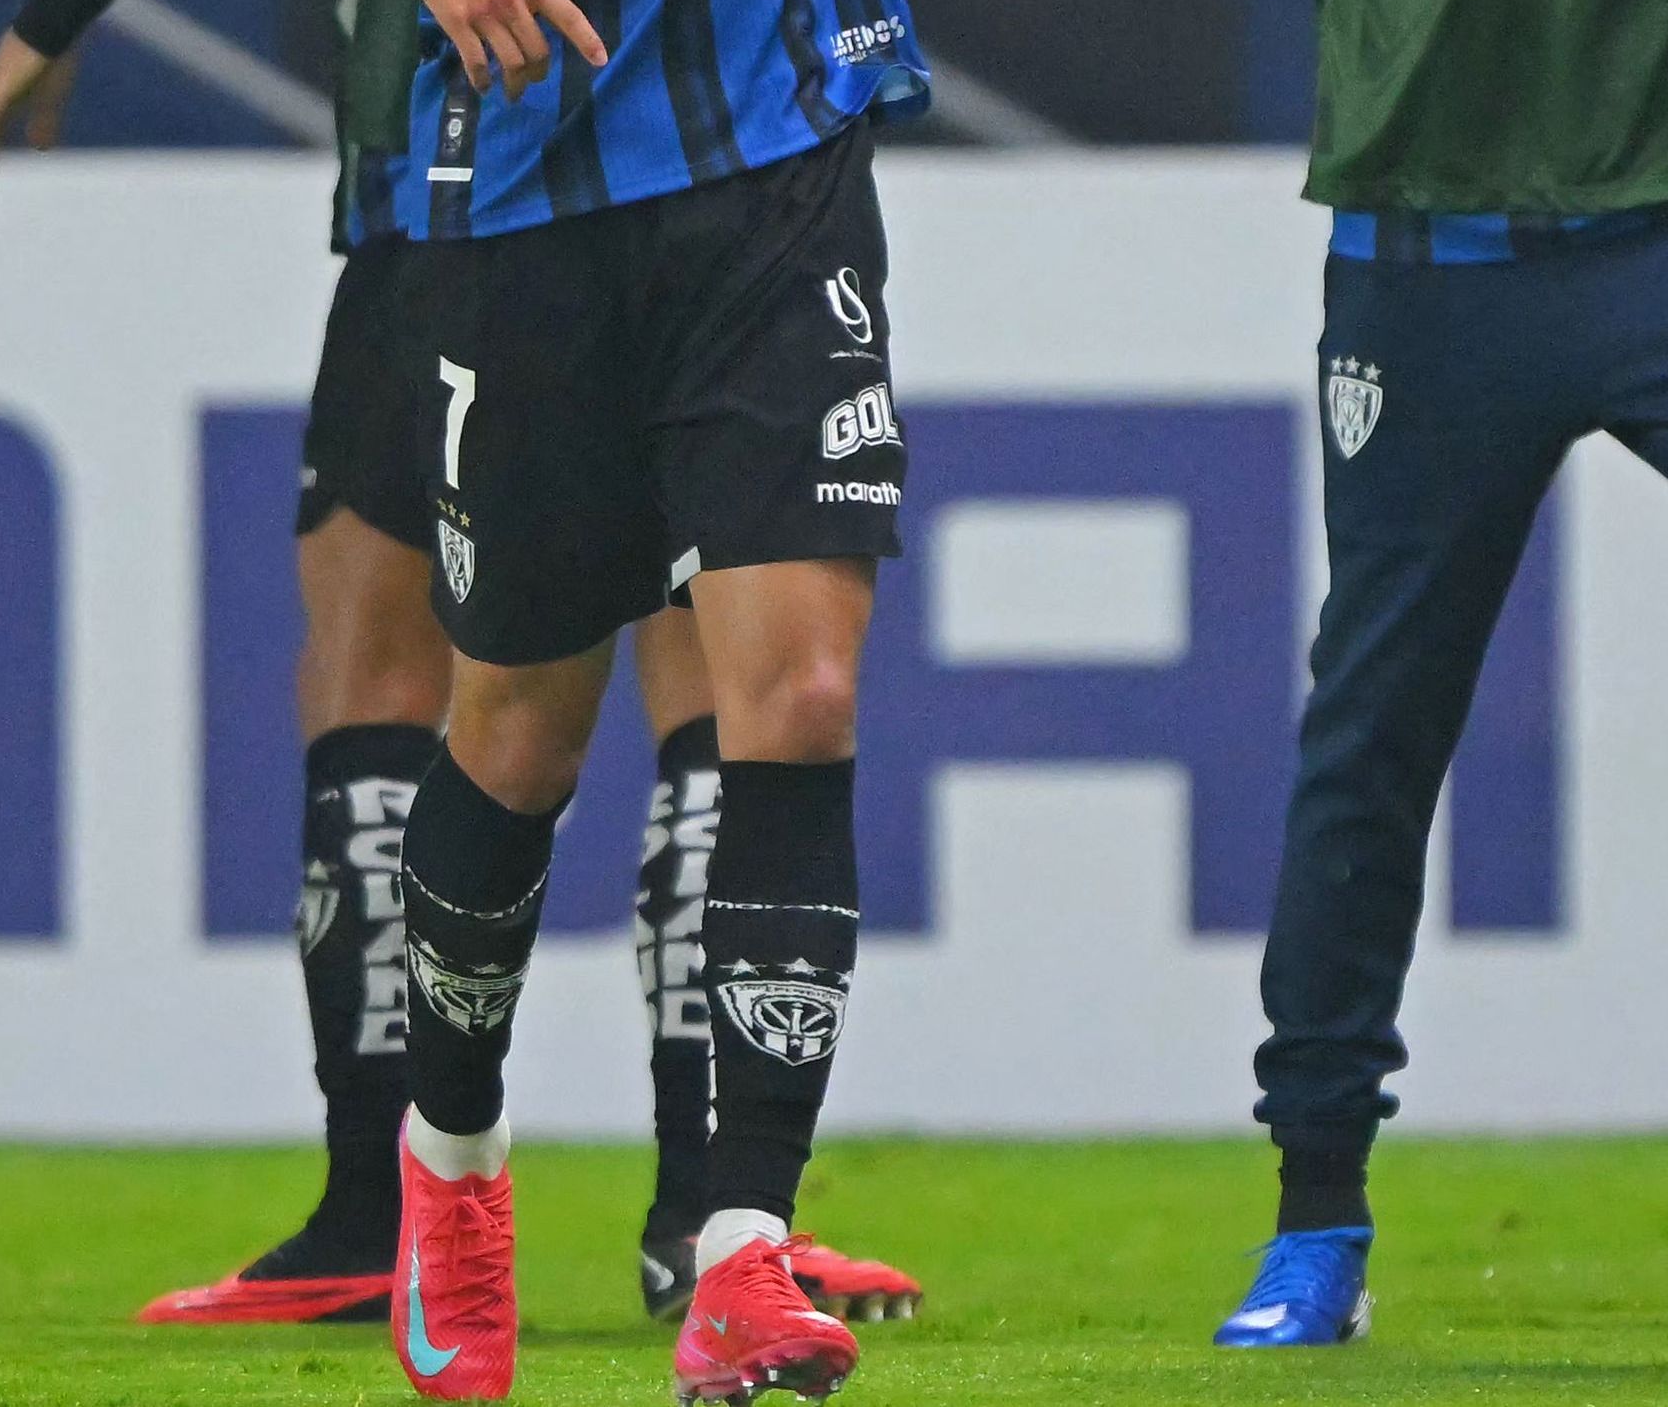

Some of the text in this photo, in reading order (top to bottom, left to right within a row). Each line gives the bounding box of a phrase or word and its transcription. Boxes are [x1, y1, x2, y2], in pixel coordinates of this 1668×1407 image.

[439, 355, 476, 490] 7
[823, 382, 903, 460] GOL
[817, 480, 901, 506] marath
